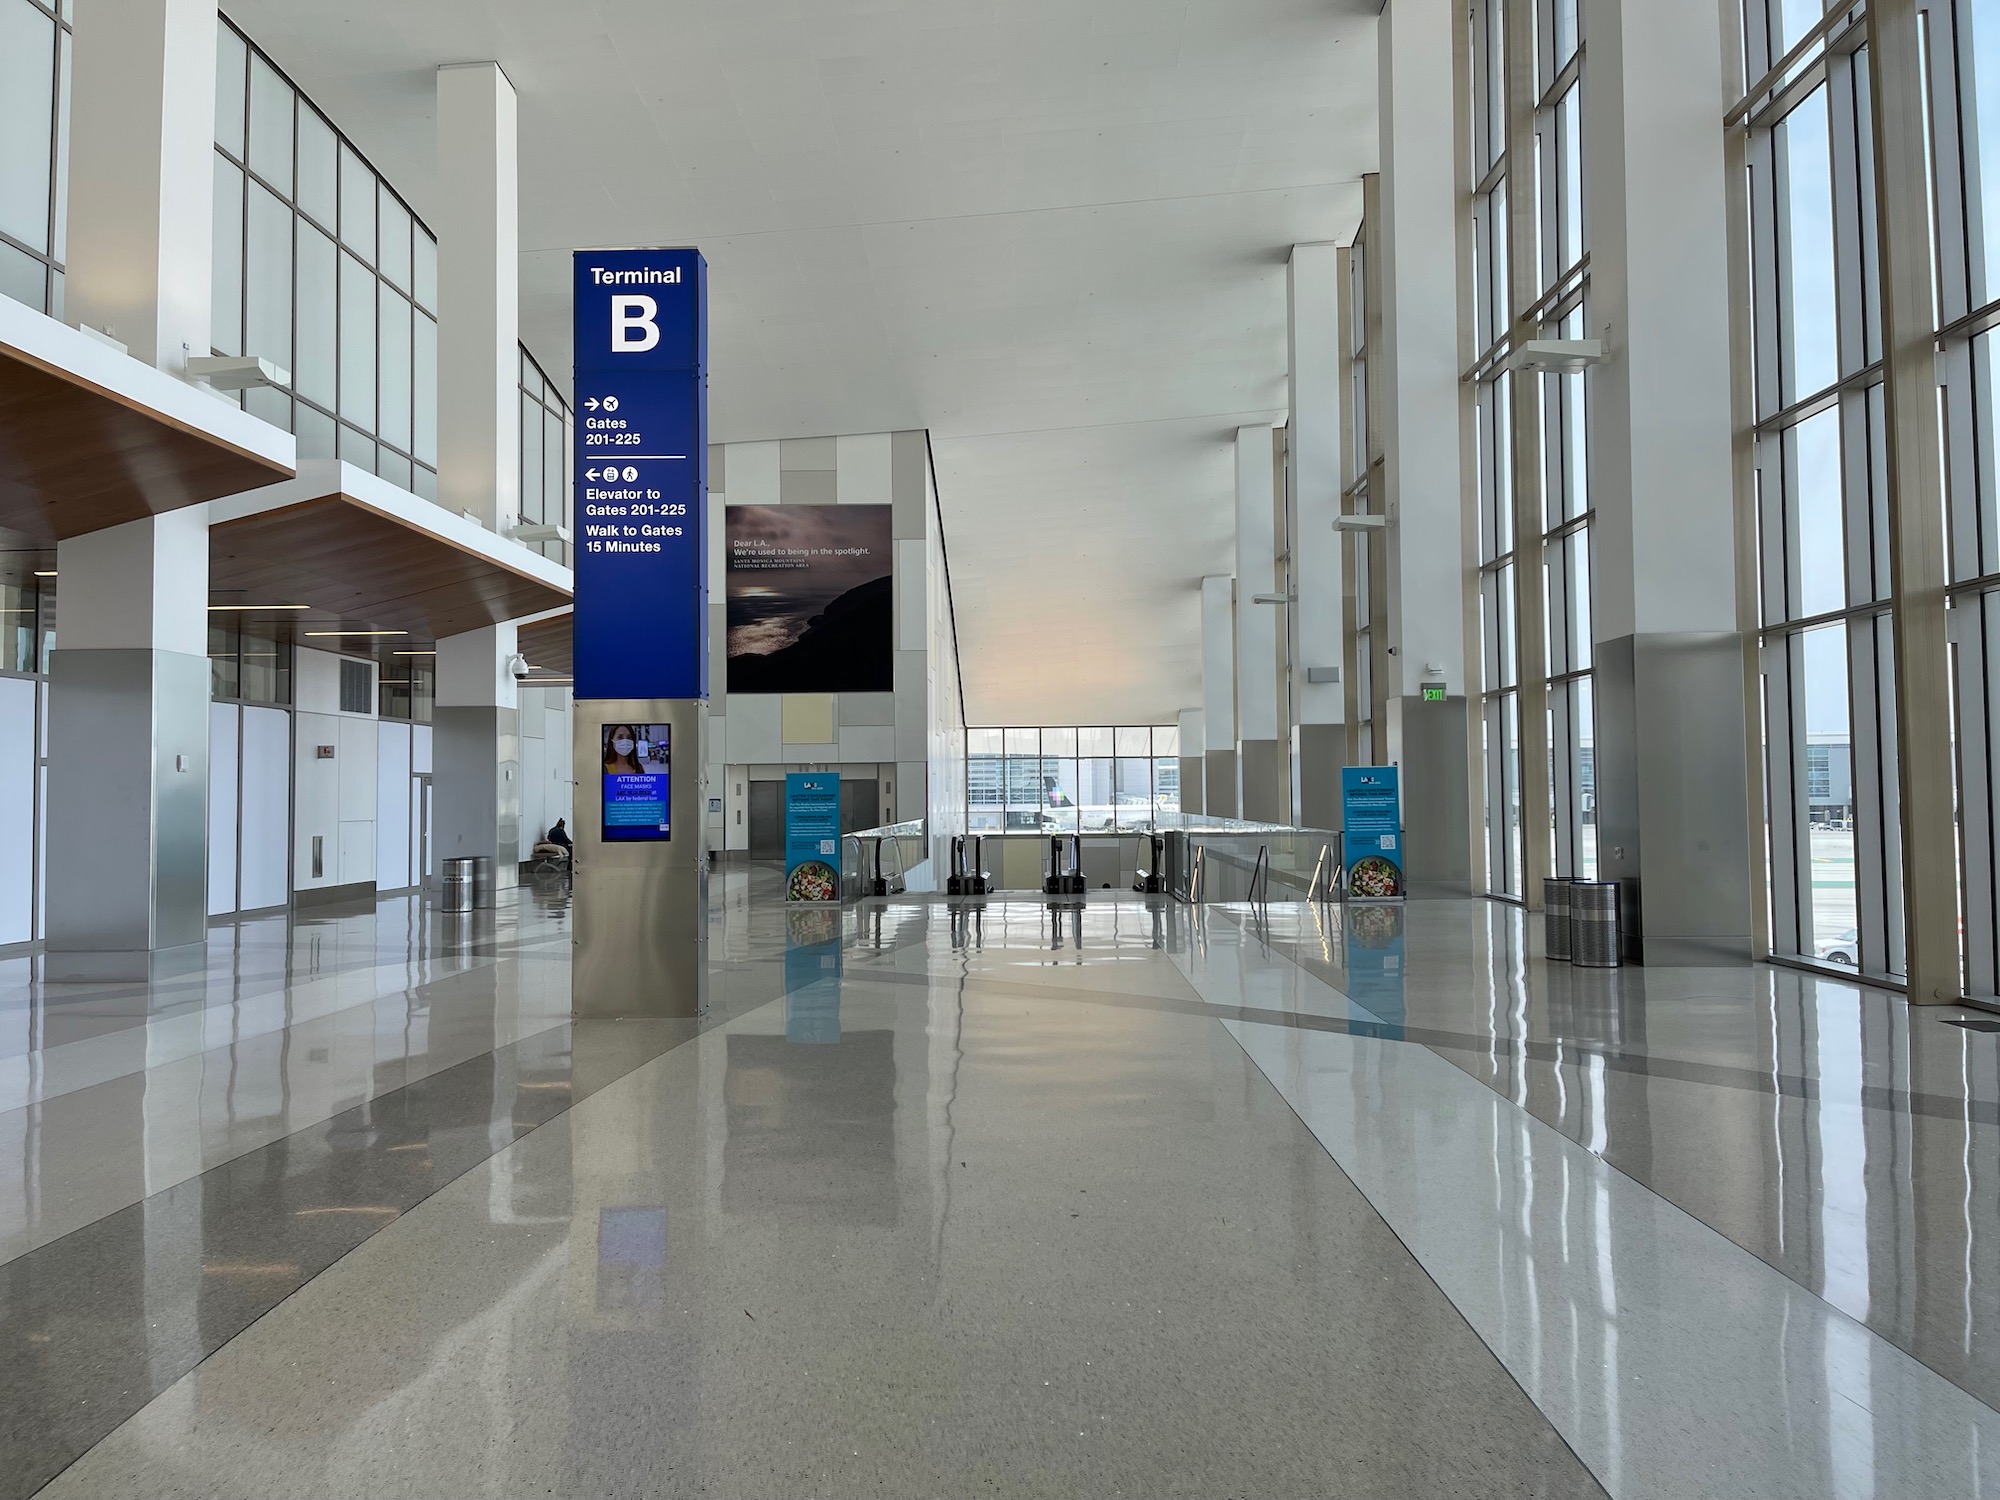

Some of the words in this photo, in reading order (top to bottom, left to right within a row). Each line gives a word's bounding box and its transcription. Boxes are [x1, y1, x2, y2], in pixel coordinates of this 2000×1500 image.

[590, 266, 681, 285] Terminal
[611, 294, 661, 353] B
[585, 417, 627, 429] Gates
[585, 433, 641, 445] 201-225
[586, 488, 643, 500] Elevator
[646, 488, 661, 500] to
[585, 504, 627, 516] Gates
[630, 504, 686, 515] 201-225
[585, 525, 620, 536] Walk
[623, 525, 637, 536] to
[641, 524, 683, 536] Gates
[586, 541, 601, 552] 15
[605, 541, 661, 552] Minutes
[733, 539, 752, 547] Dear
[753, 539, 771, 547] L.A.,
[733, 548, 756, 556] We're
[757, 547, 776, 556] used
[787, 547, 809, 556] being
[811, 547, 819, 555] in
[820, 547, 833, 555] the
[834, 547, 870, 556] spotlight.
[1427, 689, 1443, 700] EXIT
